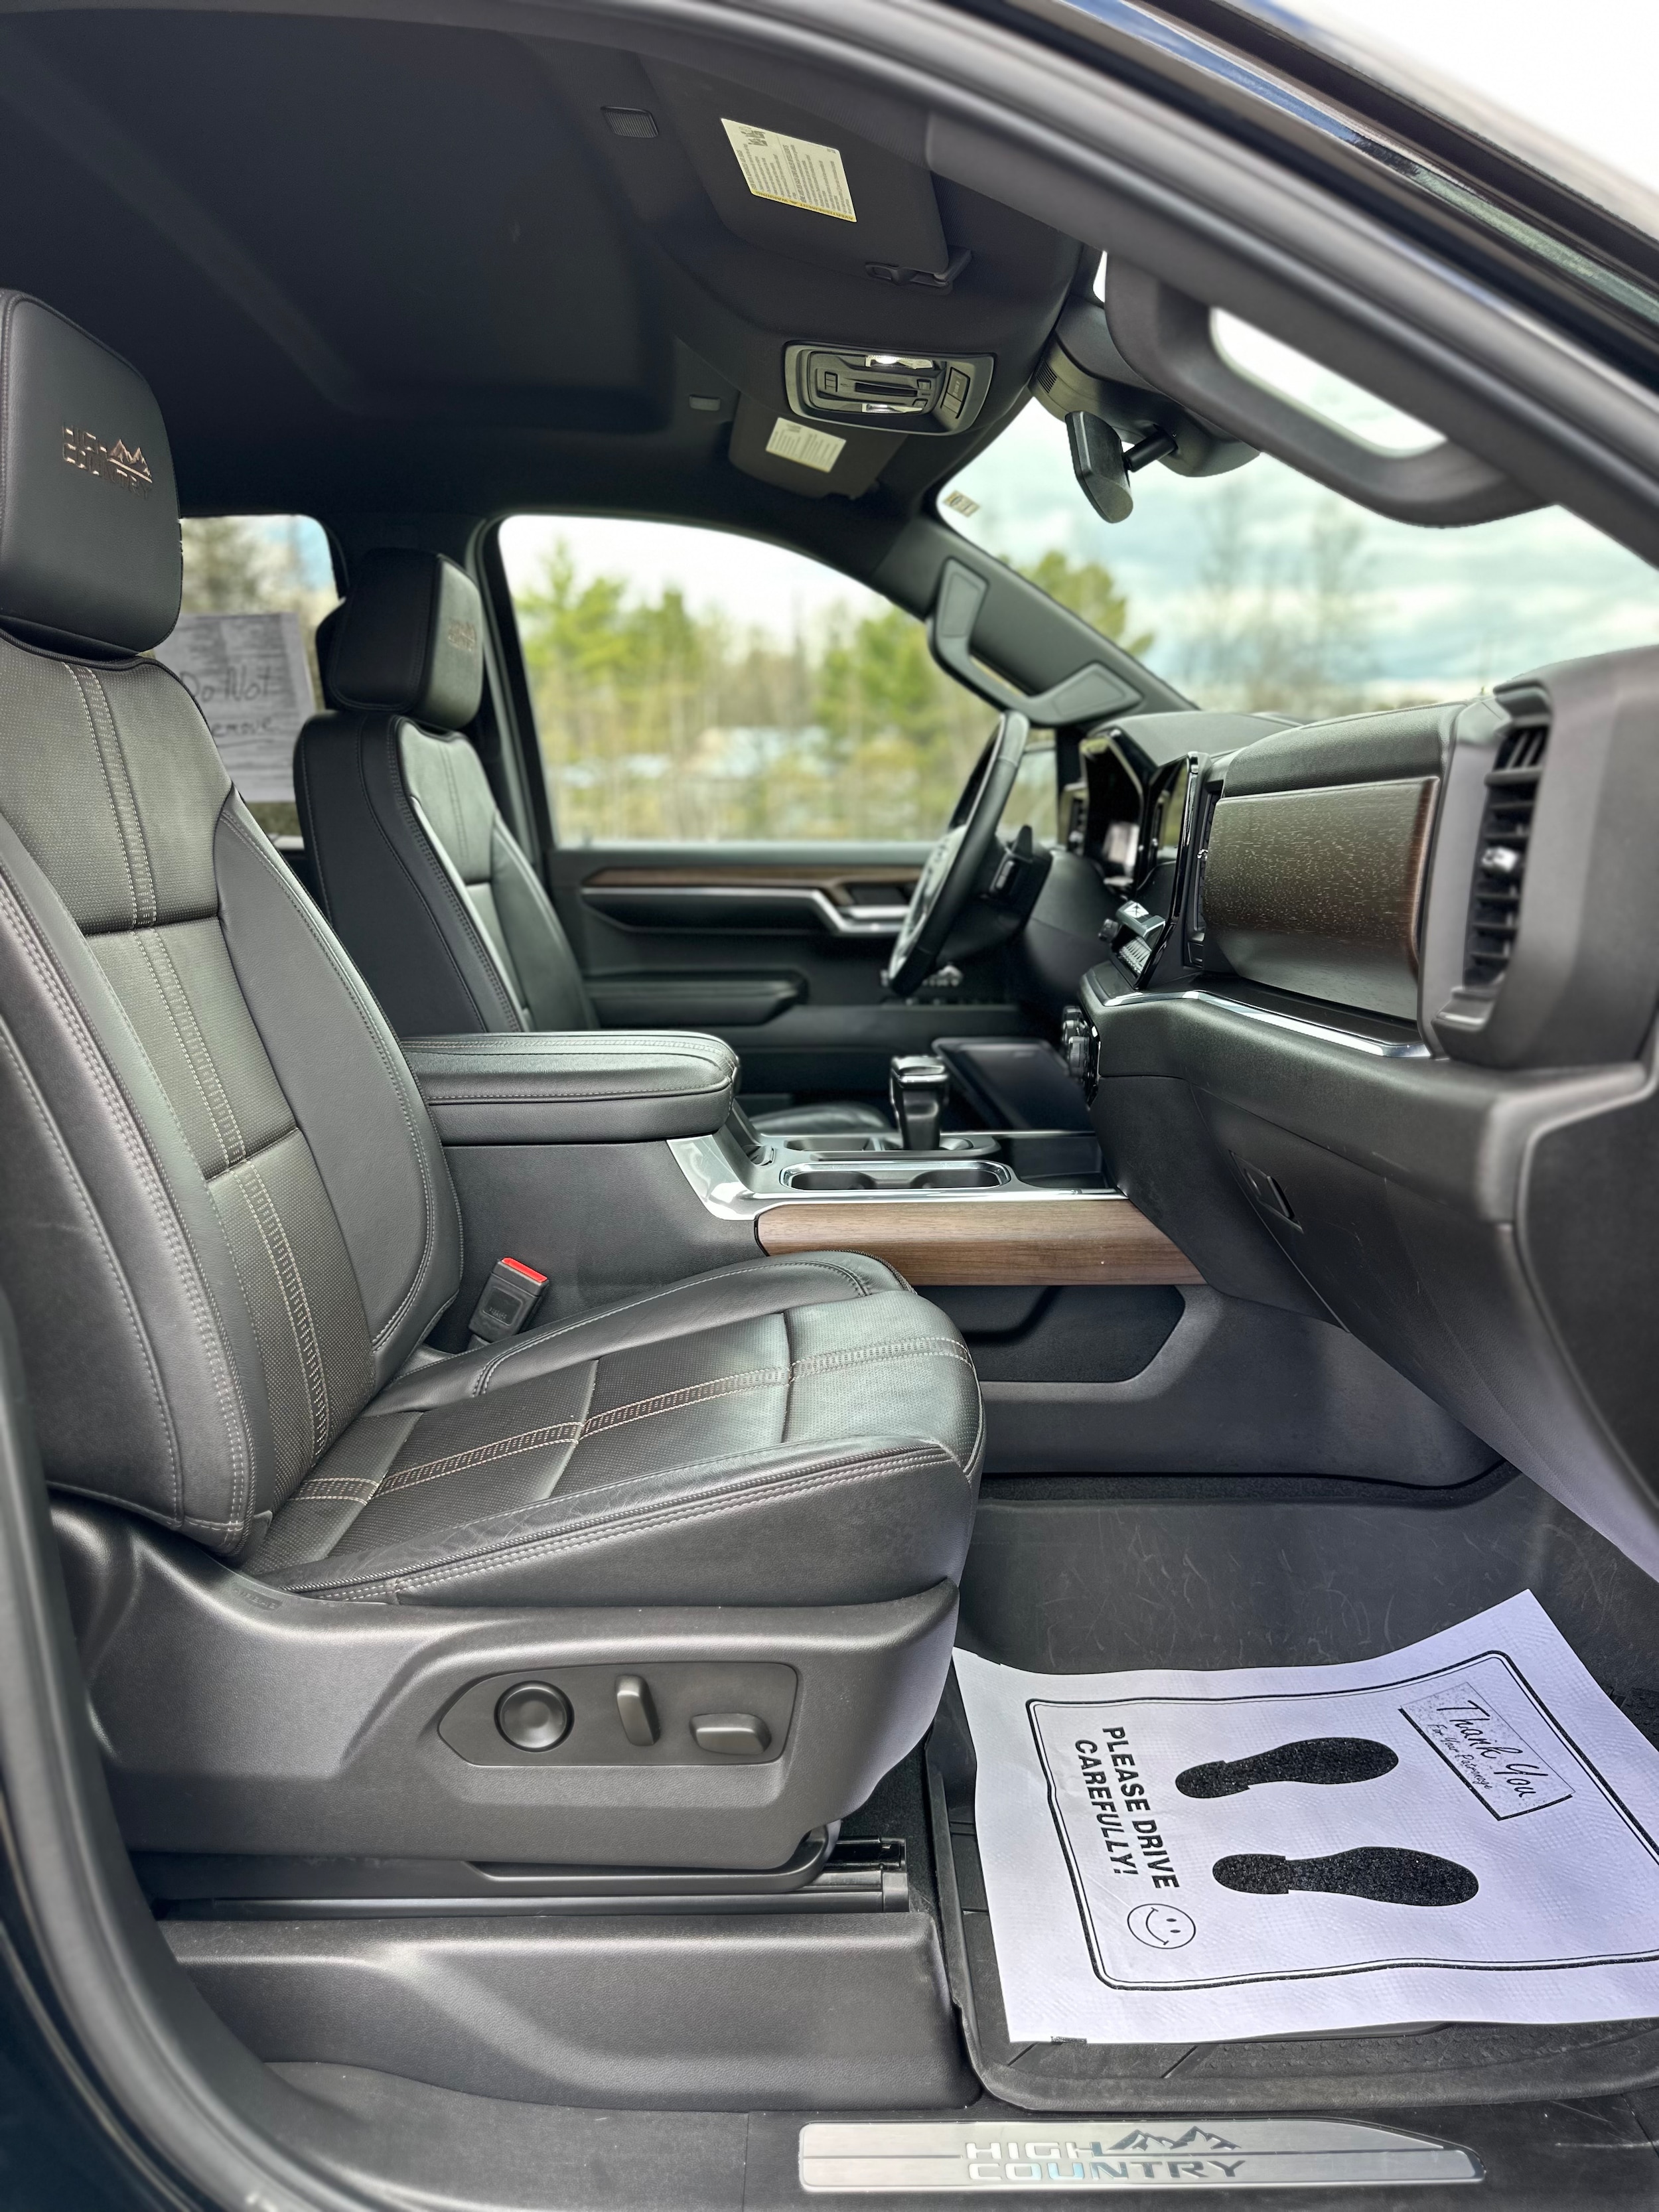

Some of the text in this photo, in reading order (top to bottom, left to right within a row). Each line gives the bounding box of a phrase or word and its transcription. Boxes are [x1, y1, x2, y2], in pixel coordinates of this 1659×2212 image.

[1427, 1724, 1493, 1790] For Your Patronage
[1436, 1700, 1549, 1798] Thank You
[1074, 1739, 1139, 1876] CAREFULLY!
[1102, 1726, 1181, 1889] PLEASE DRIVE
[964, 2141, 1104, 2160] HIGH
[968, 2159, 1246, 2181] COUNTRY
